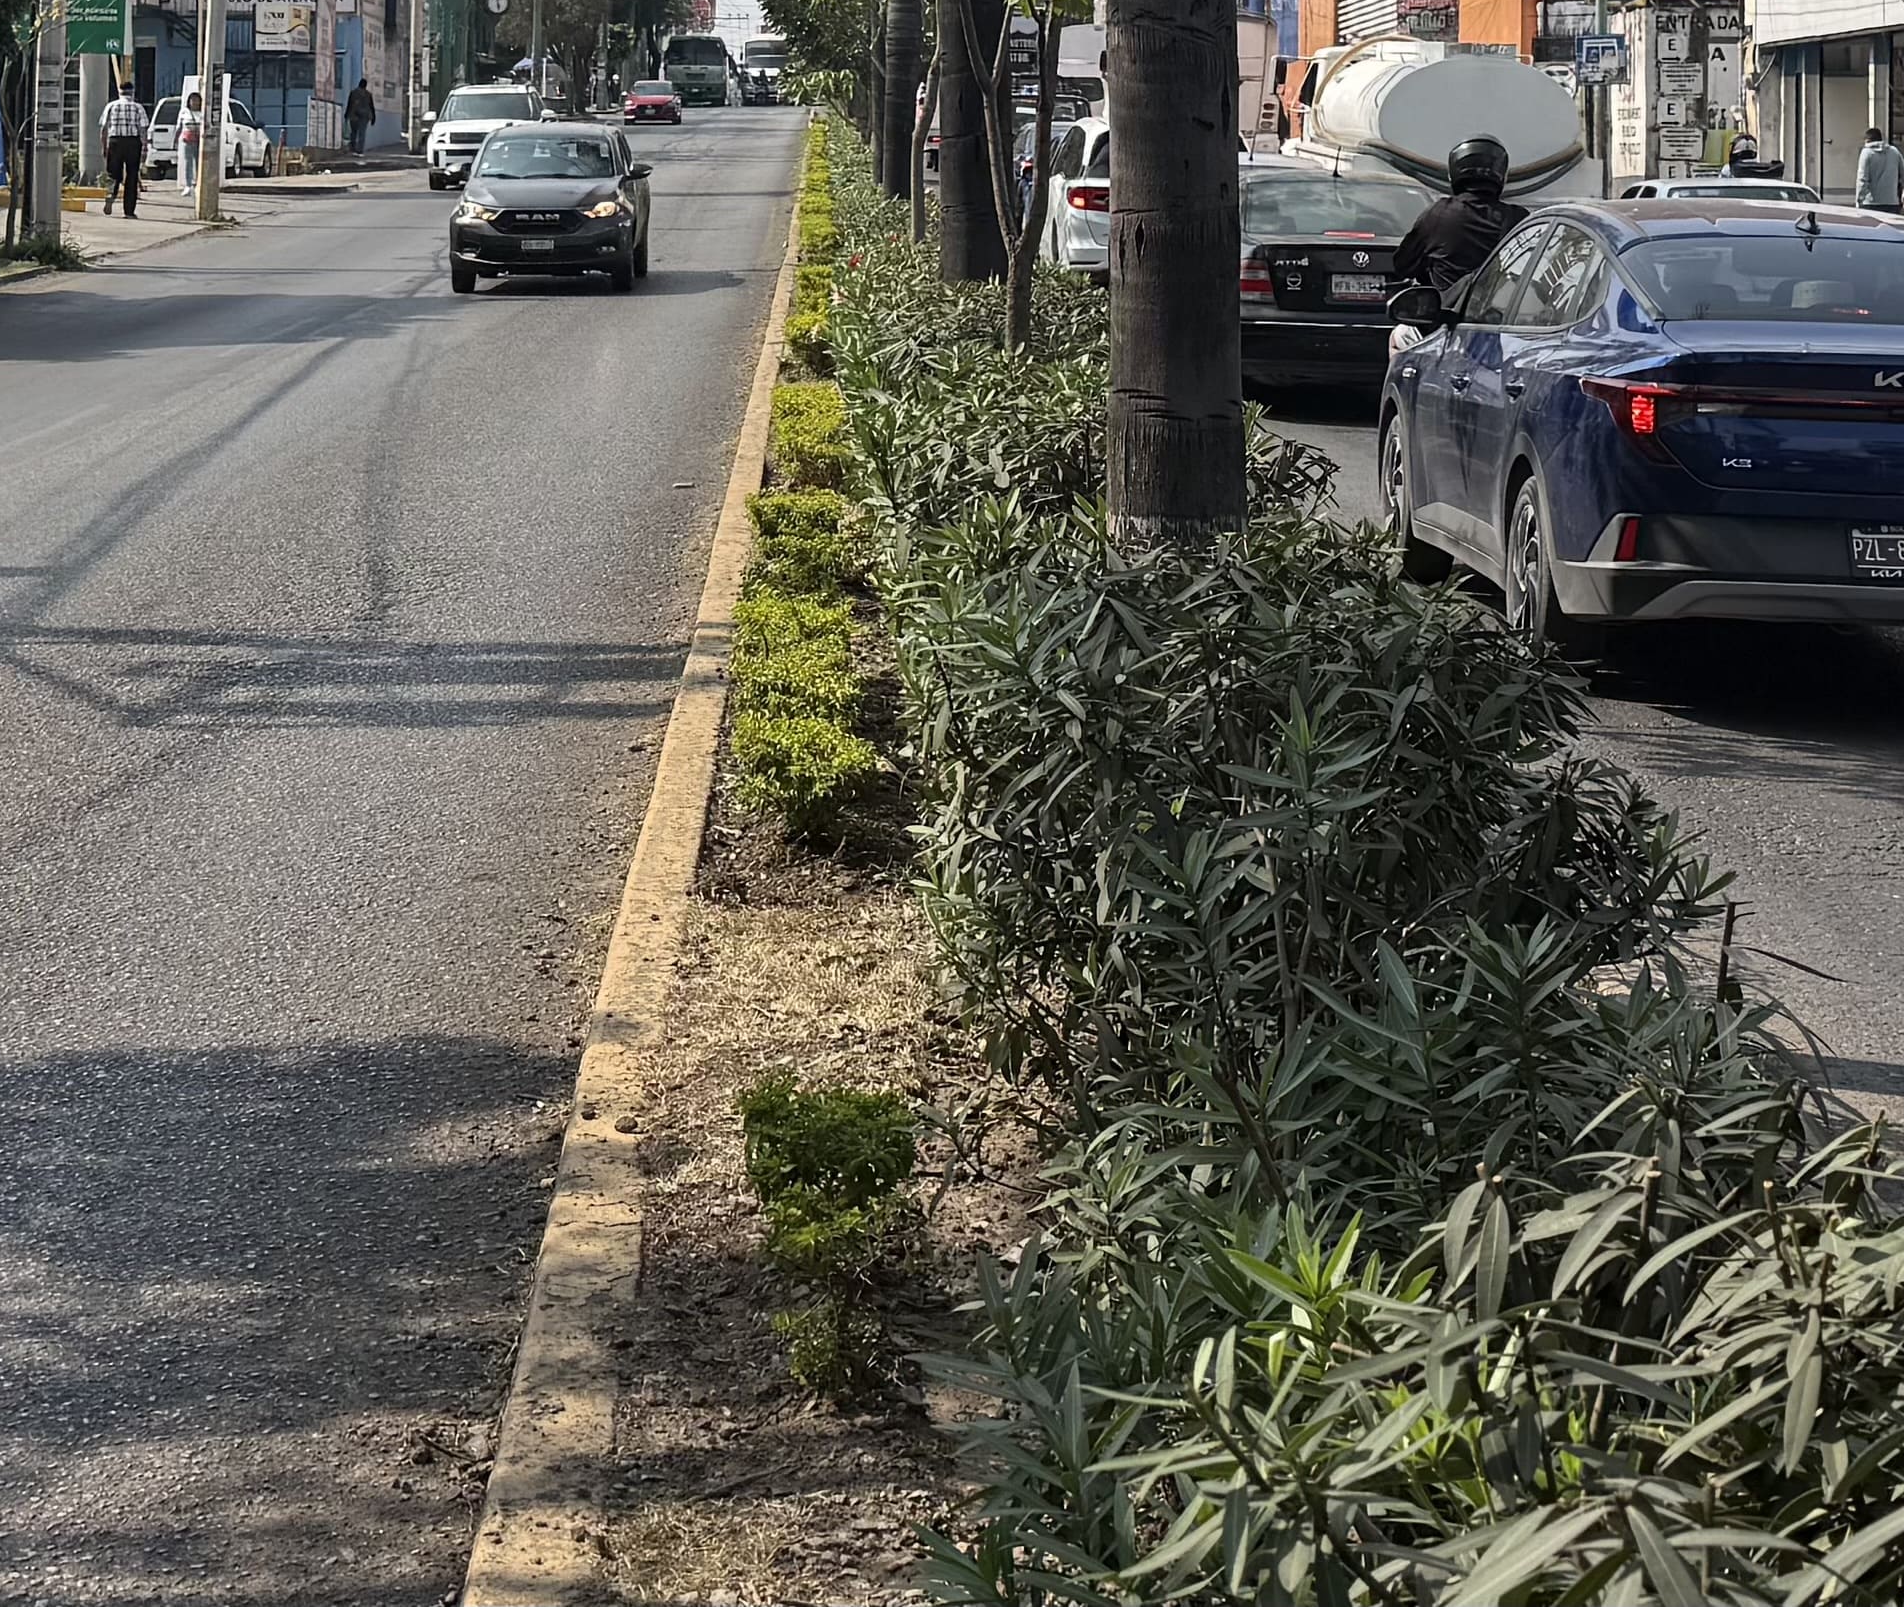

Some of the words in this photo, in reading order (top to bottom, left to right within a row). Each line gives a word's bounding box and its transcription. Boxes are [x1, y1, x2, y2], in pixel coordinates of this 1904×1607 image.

[1655, 14, 1740, 31] ENTADA
[1668, 38, 1677, 51] E
[1667, 103, 1676, 116] E
